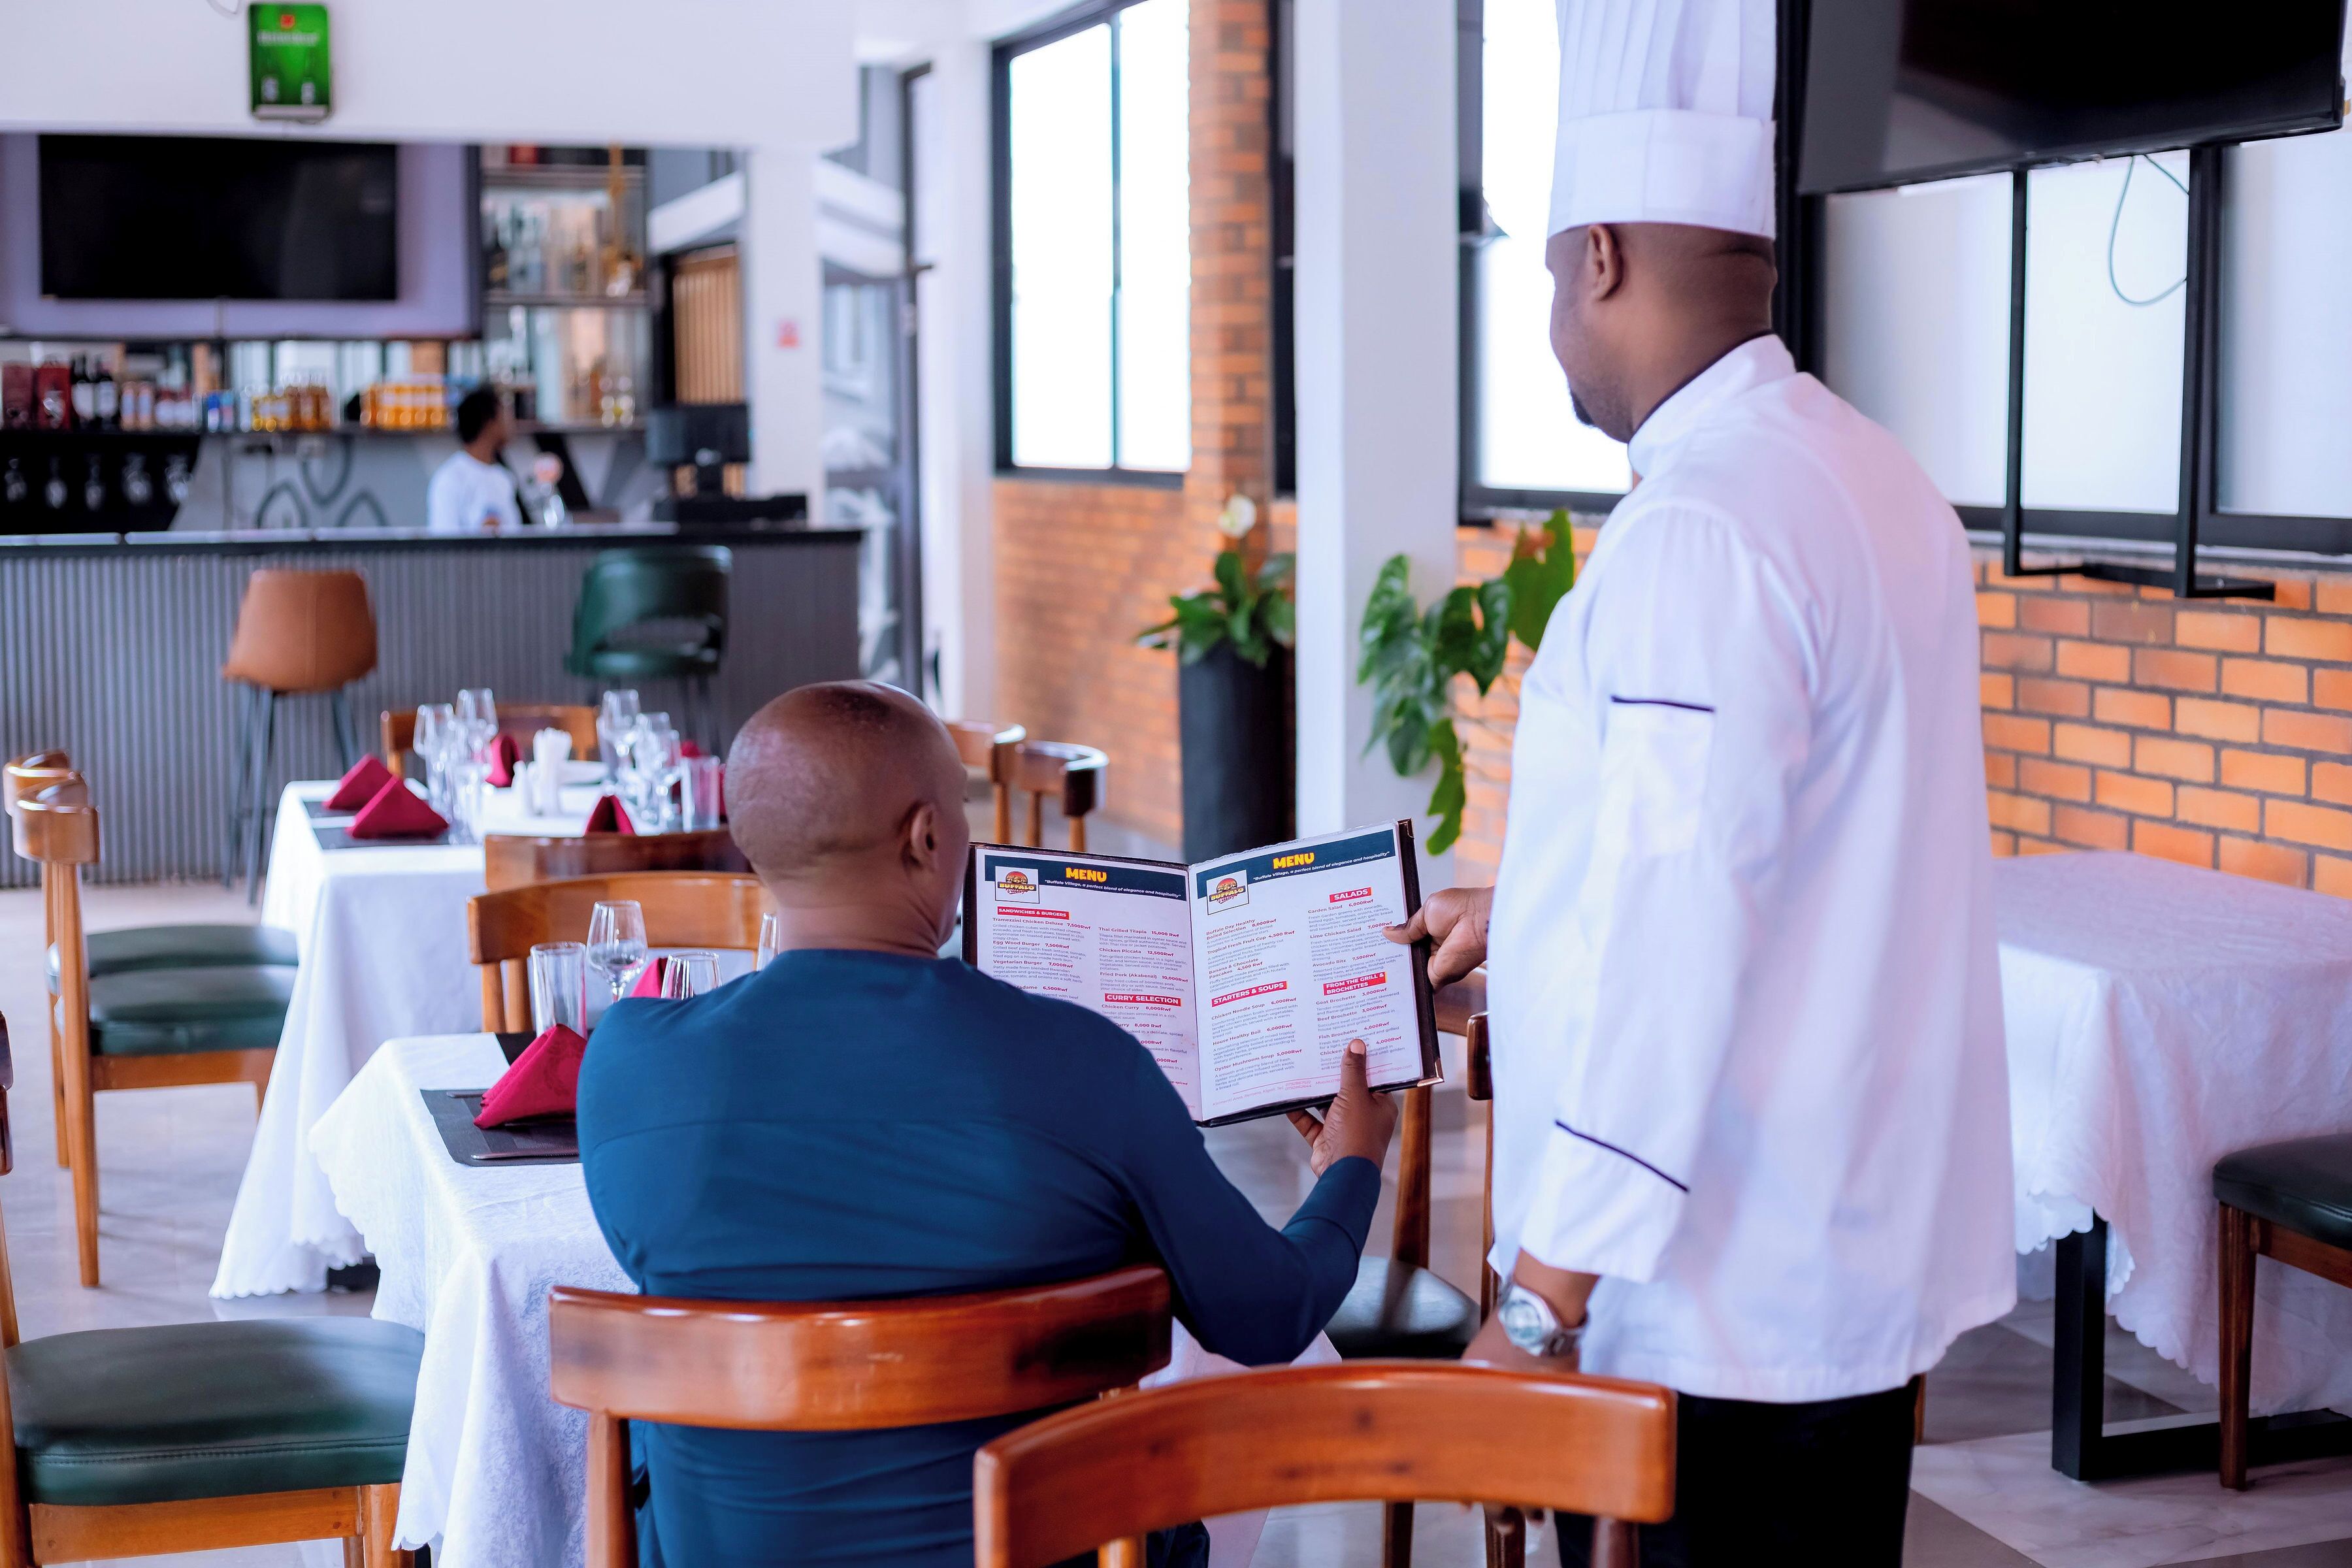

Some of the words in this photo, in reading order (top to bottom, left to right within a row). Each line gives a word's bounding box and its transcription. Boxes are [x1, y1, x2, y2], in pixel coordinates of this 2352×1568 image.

[1273, 852, 1315, 869] MENU
[1294, 866, 1311, 875] perfect
[1066, 868, 1107, 883] MENU
[1211, 888, 1244, 900] BUFFALO
[1334, 889, 1368, 900] SALADS
[1223, 926, 1247, 935] Selection
[1207, 945, 1227, 954] Tropical
[1352, 953, 1377, 961] 7,500Rwf
[1233, 958, 1259, 967] Chocolate
[1209, 970, 1233, 979] Pancakes
[1326, 982, 1369, 994] BROCHETTES
[1362, 987, 1387, 996] 3,000Rwf
[1214, 990, 1250, 1004] STARTERS
[1258, 983, 1284, 992] SOUPS
[1362, 1004, 1387, 1013] 3,000Rwf
[1364, 1022, 1390, 1030] 4,000Rwf
[1376, 1036, 1401, 1045] 4,000Rwf
[1232, 1058, 1260, 1067] Mushroom
